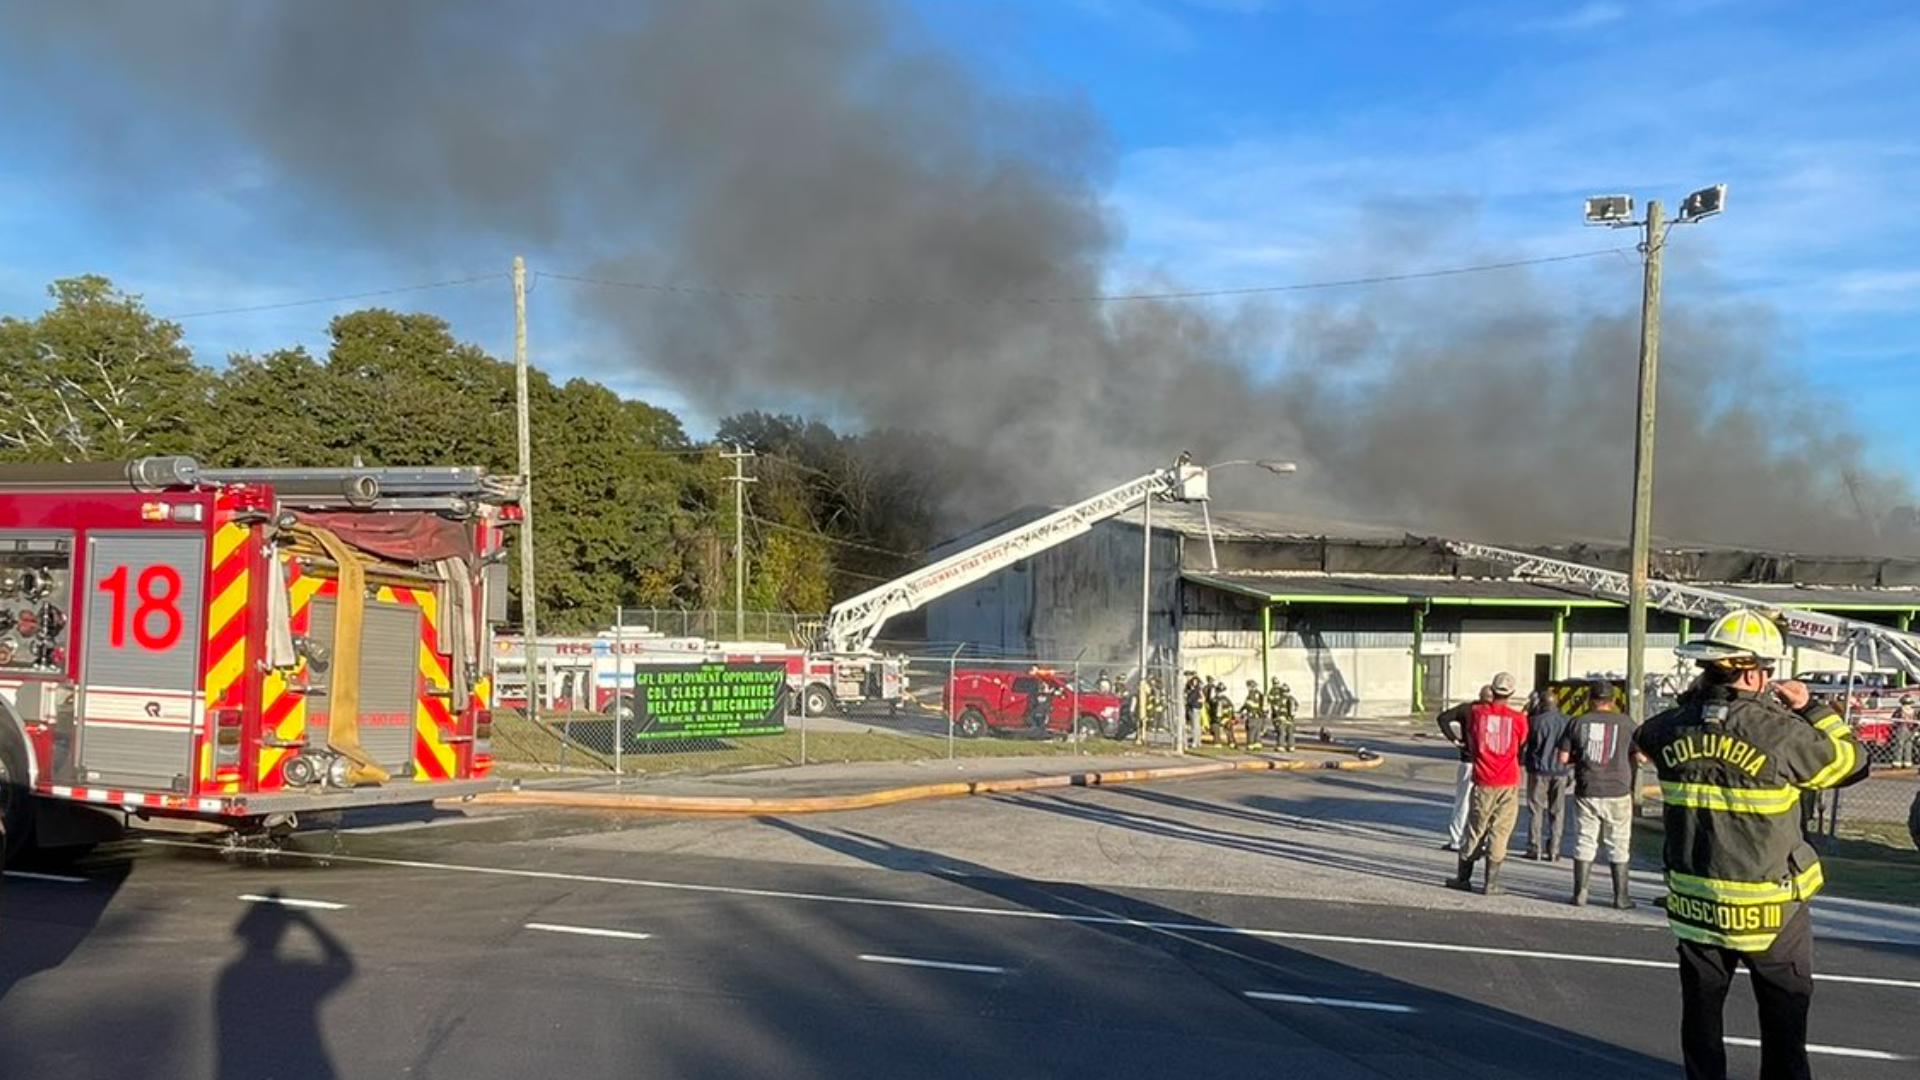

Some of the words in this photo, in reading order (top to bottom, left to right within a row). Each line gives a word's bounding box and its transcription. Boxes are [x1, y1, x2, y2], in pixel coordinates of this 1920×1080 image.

[98, 564, 183, 651] 18
[637, 673, 655, 685] GFL
[658, 671, 720, 685] EMPLOYMENT
[722, 671, 784, 684] OPPORTUNITY
[647, 686, 667, 700] CDL
[671, 685, 705, 699] CLASS
[732, 684, 775, 697] DRIVERS
[647, 700, 697, 714] HELPERS
[712, 698, 775, 712] MECHANICS
[1661, 734, 1767, 777] COLUMBIA
[1763, 904, 1781, 928] III
